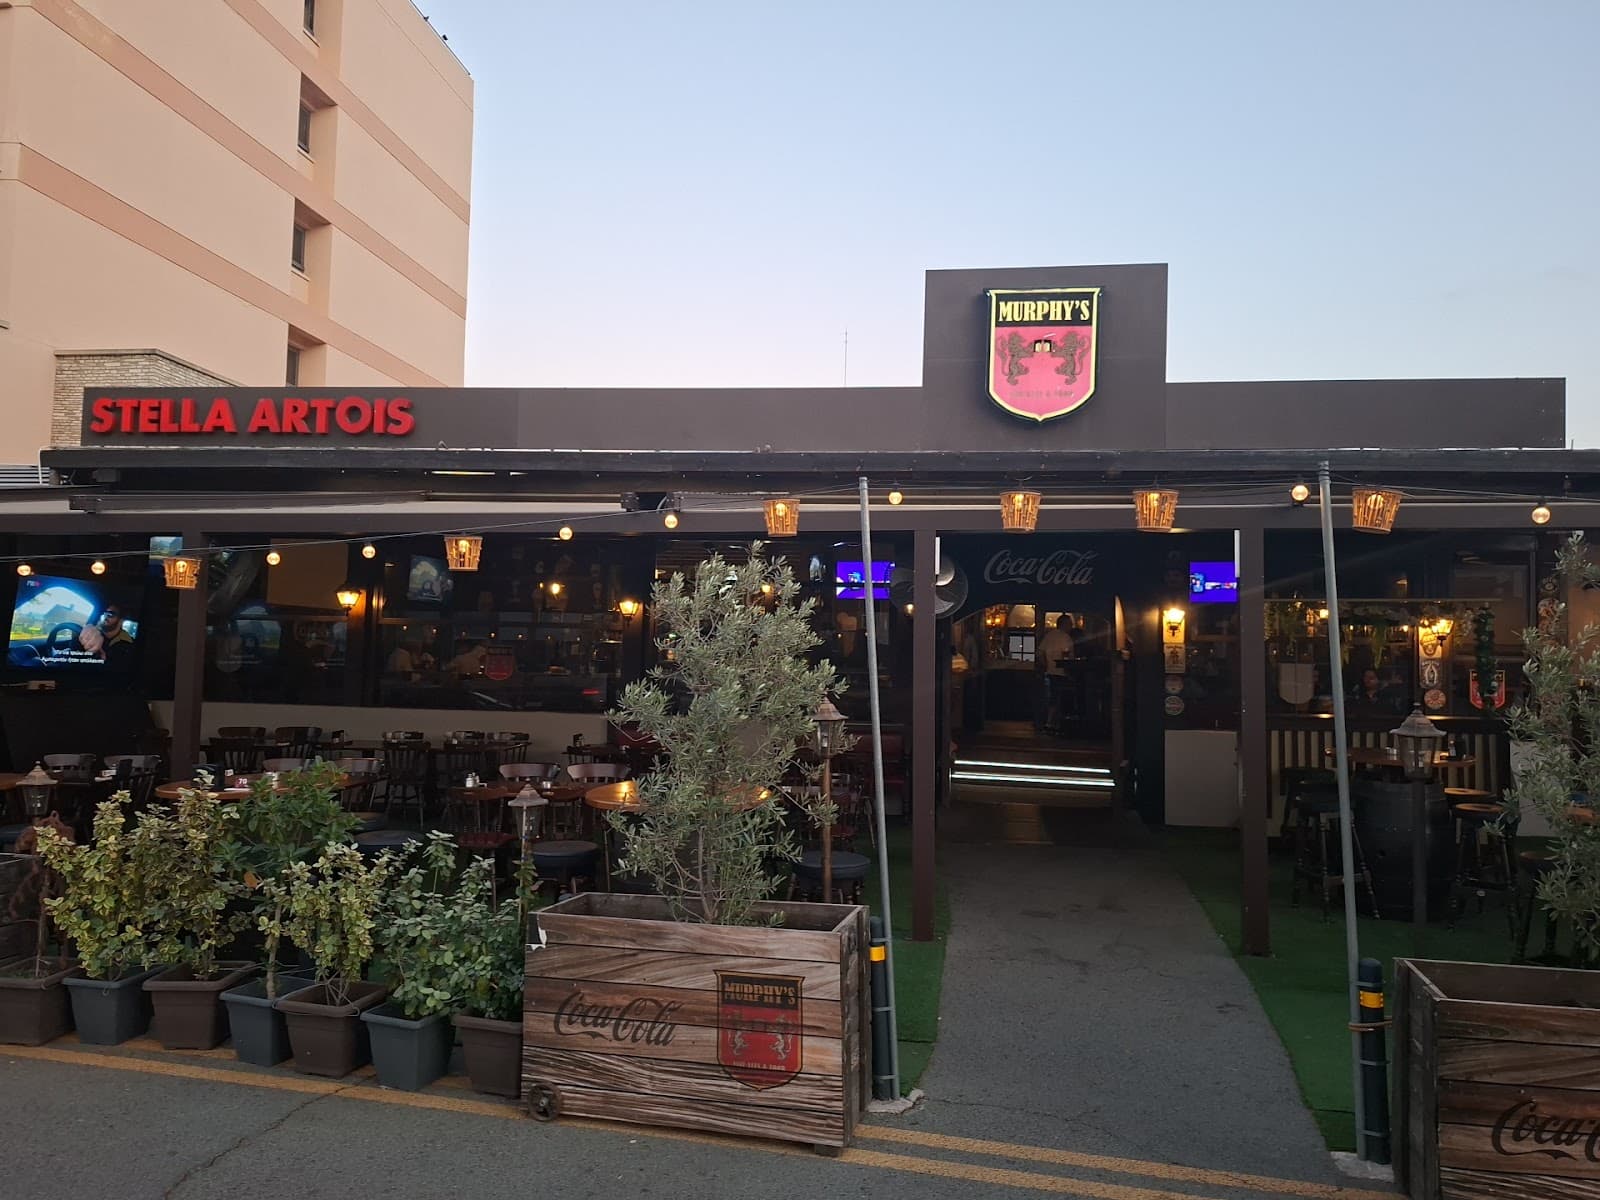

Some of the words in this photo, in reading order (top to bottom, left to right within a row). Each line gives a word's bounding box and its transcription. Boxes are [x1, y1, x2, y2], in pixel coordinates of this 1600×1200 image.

[998, 300, 1090, 322] MURPHY'S
[90, 397, 237, 433] STELLA
[247, 396, 415, 435] ARTOIS
[983, 549, 1098, 585] Coca-Cola
[724, 982, 796, 1005] MURPHY'S
[553, 991, 682, 1046] Coca-Cola
